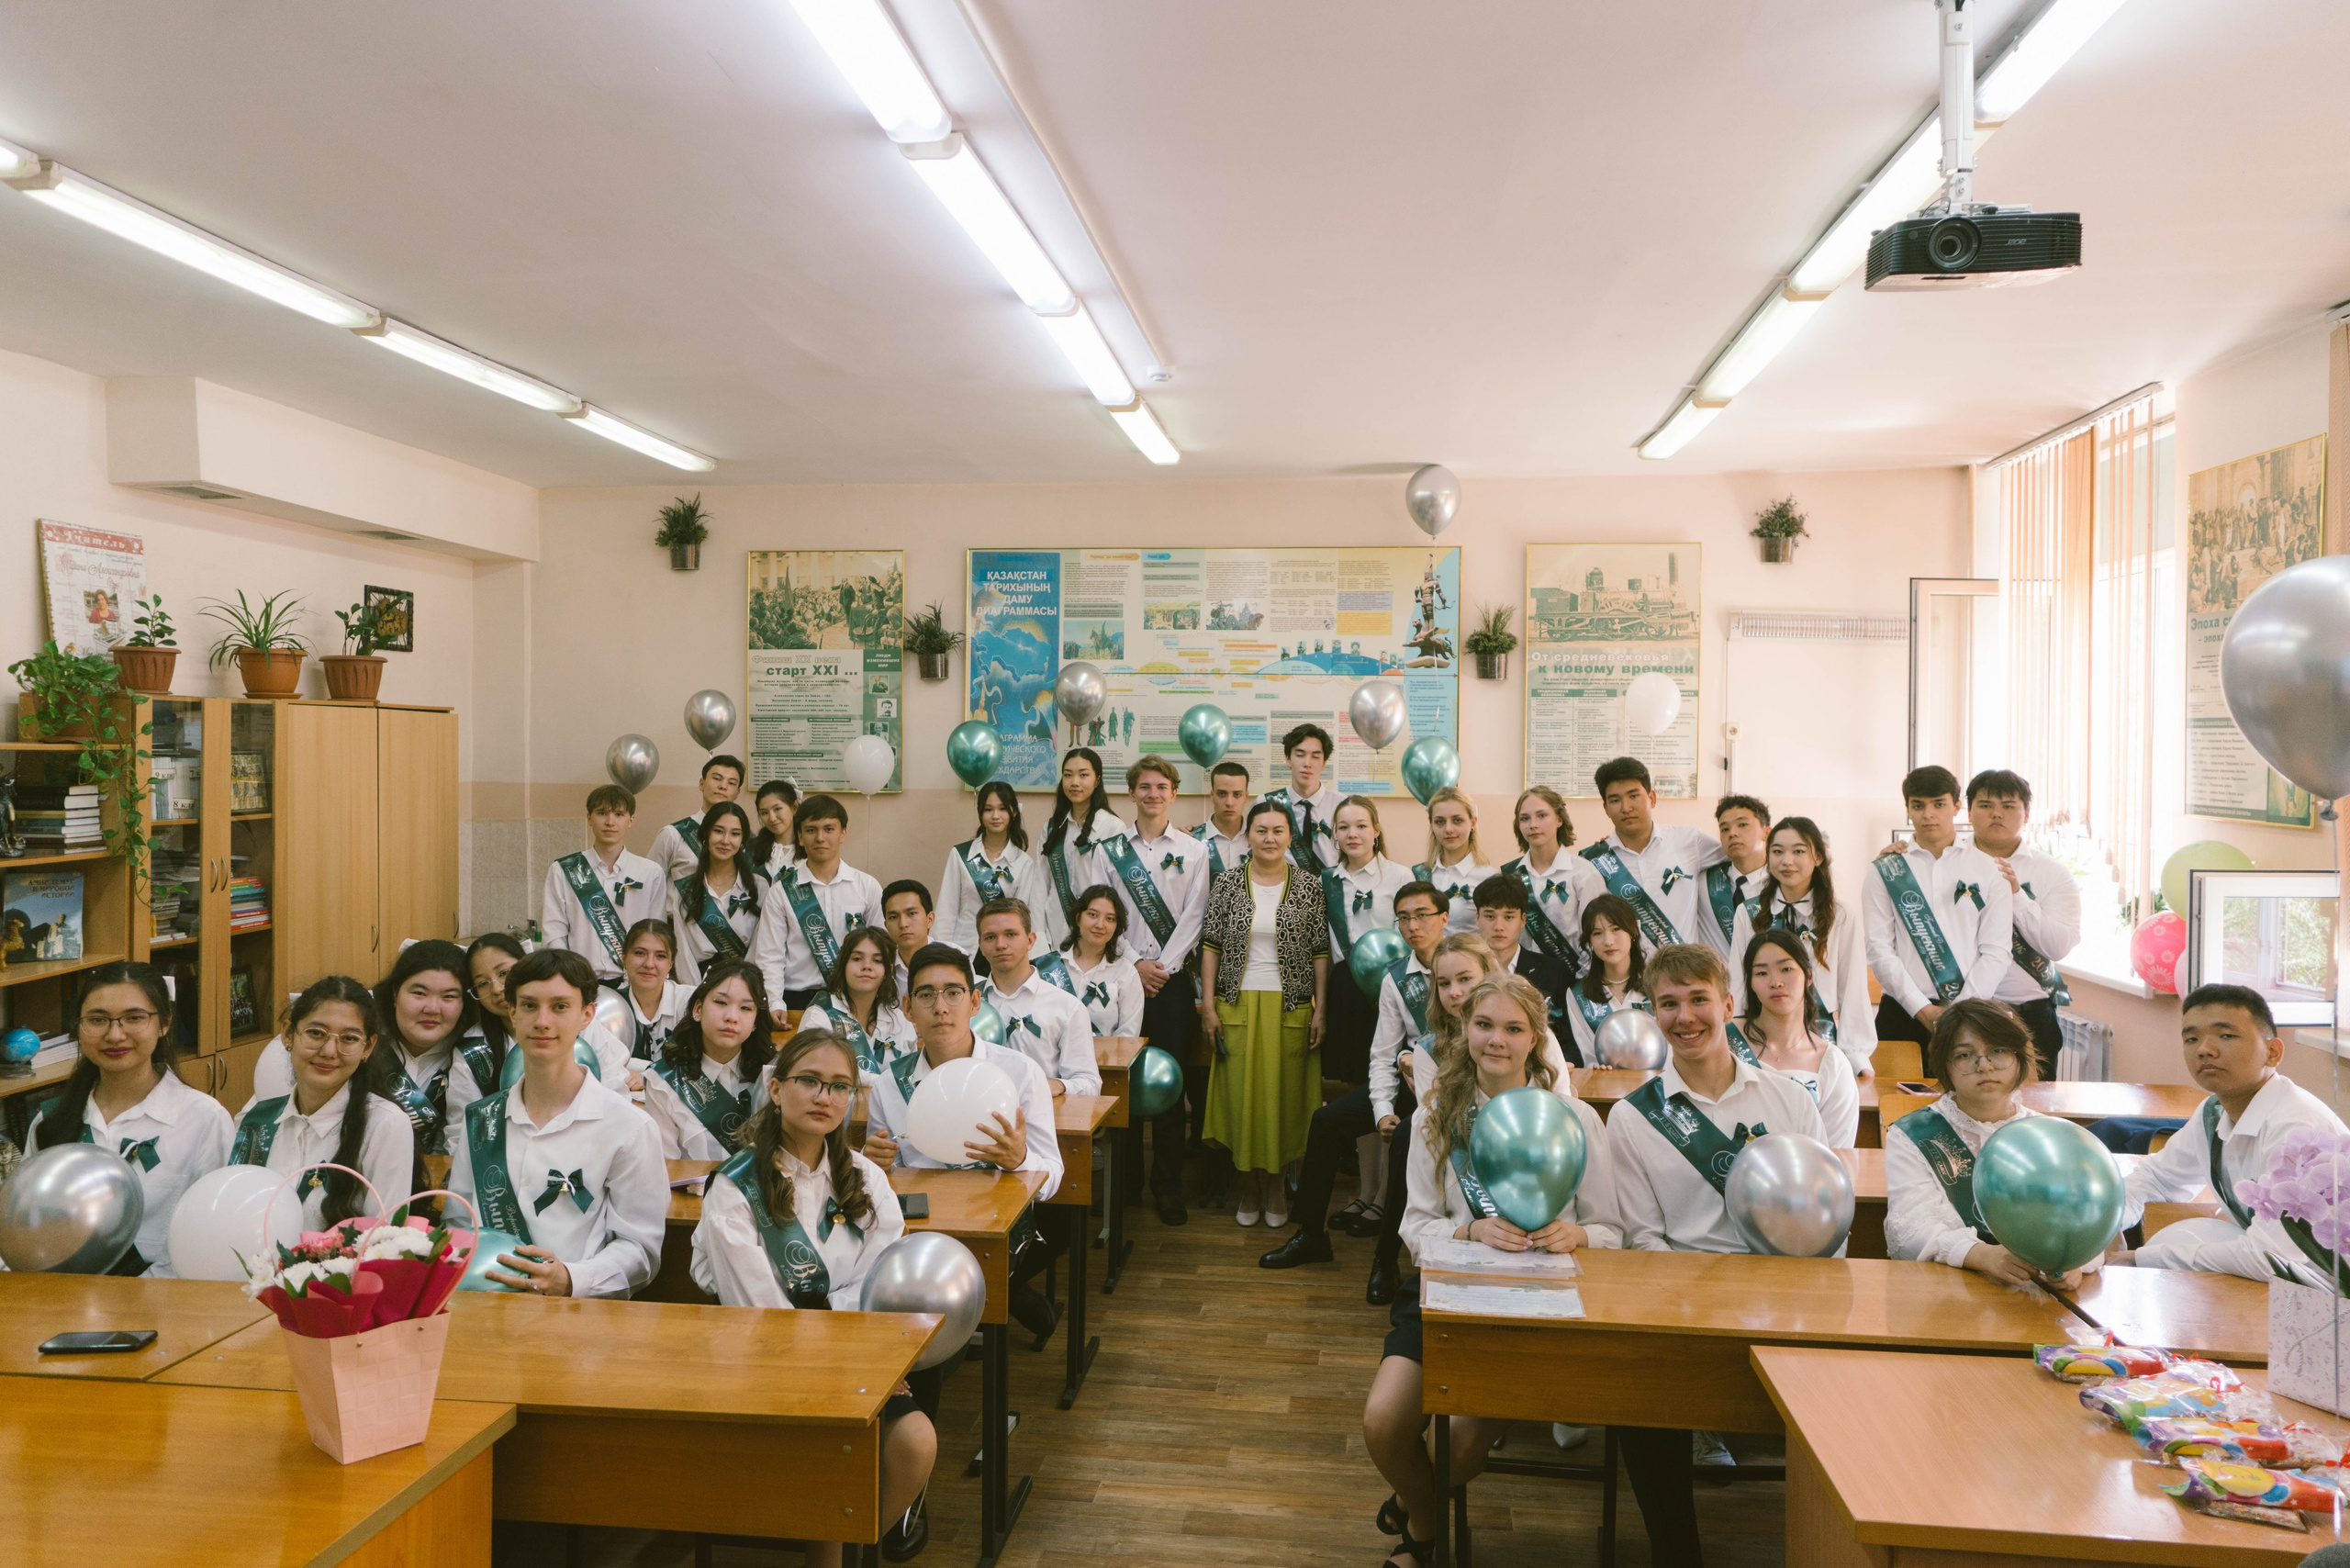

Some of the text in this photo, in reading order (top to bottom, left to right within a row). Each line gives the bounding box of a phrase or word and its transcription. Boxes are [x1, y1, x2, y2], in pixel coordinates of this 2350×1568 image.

[63, 531, 126, 548] Учитель
[88, 562, 140, 579] Александровна
[987, 571, 1046, 581] ҚАЗАҚСТАН
[983, 583, 1051, 593] ТАРИХЫНЫҢ
[1003, 595, 1033, 604] ДАМУ
[976, 606, 1057, 616] ДИАГРАММАСЫ
[2190, 618, 2220, 630] Эпоха
[752, 655, 792, 664] Финиш
[1531, 652, 1669, 663] От средневековья
[767, 667, 807, 678] старт
[812, 666, 838, 675] XXI
[1554, 666, 1615, 676] новому
[1622, 666, 1695, 676] времени
[1002, 756, 1034, 764] ЗВИТИЯ
[998, 766, 1041, 775] УДАРСТВА
[1127, 867, 1169, 935] Выпускник
[1621, 883, 1671, 946] Выпускни
[1900, 890, 1946, 971] Выпускник
[1945, 982, 1959, 1000] 20
